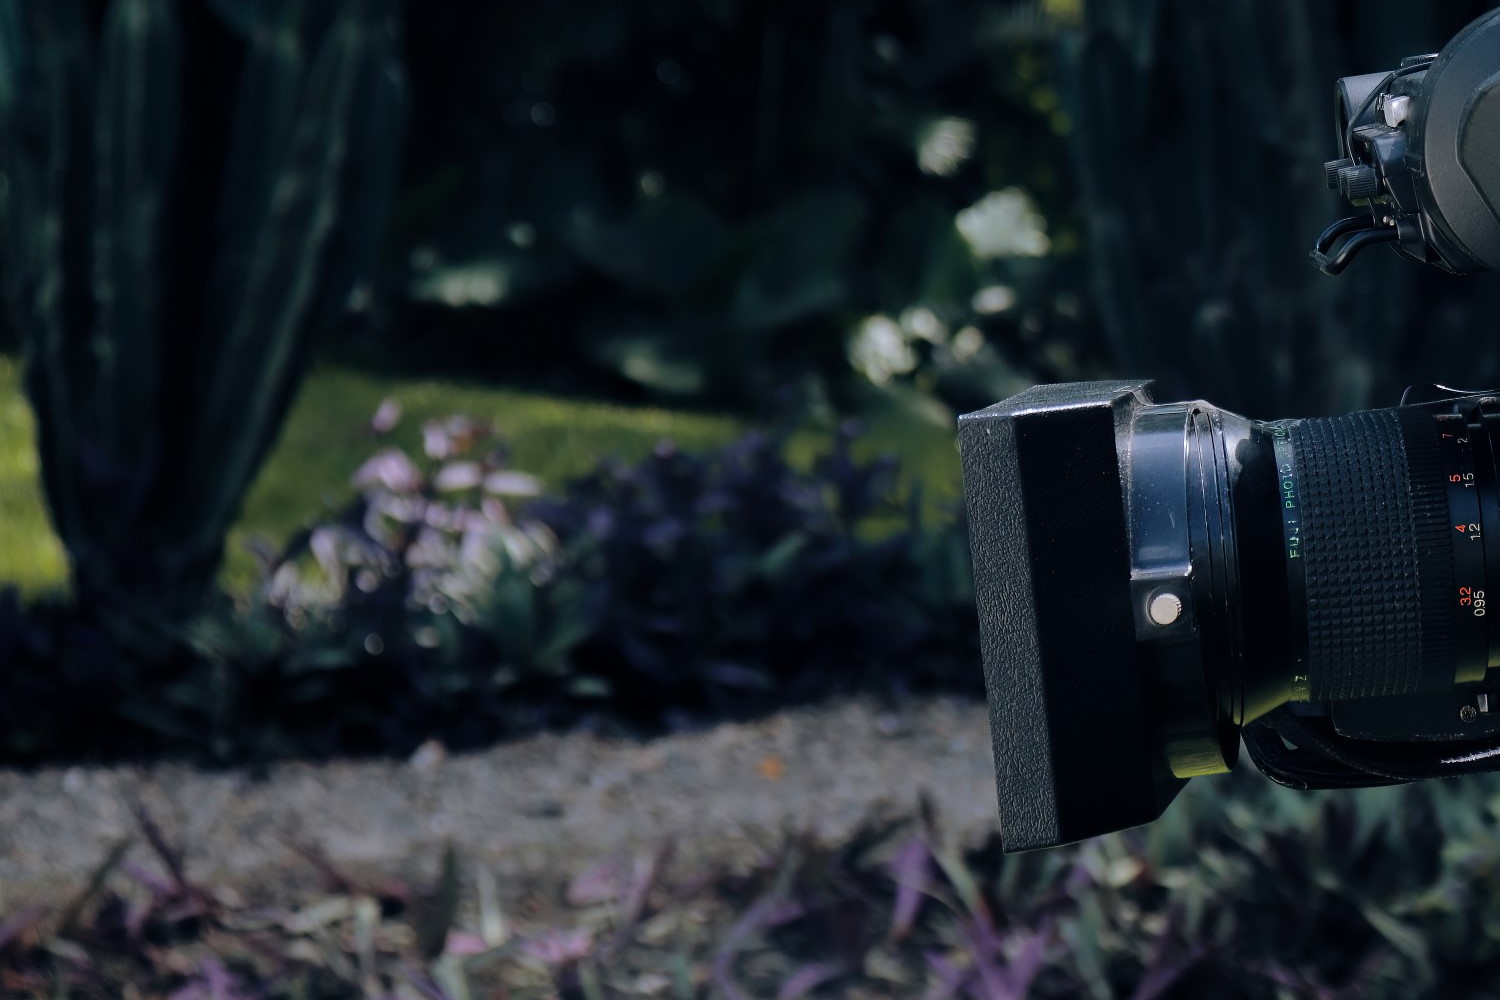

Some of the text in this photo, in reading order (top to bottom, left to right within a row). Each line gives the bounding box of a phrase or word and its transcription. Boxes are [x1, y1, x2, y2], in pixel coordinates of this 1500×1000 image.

[1458, 436, 1468, 444] 2
[1450, 474, 1461, 482] 5
[1463, 472, 1475, 487] 1.5
[1455, 524, 1467, 533] 4
[1469, 523, 1481, 541] 1.2
[1460, 586, 1472, 606] 3.2
[1473, 590, 1485, 617] 0.95
